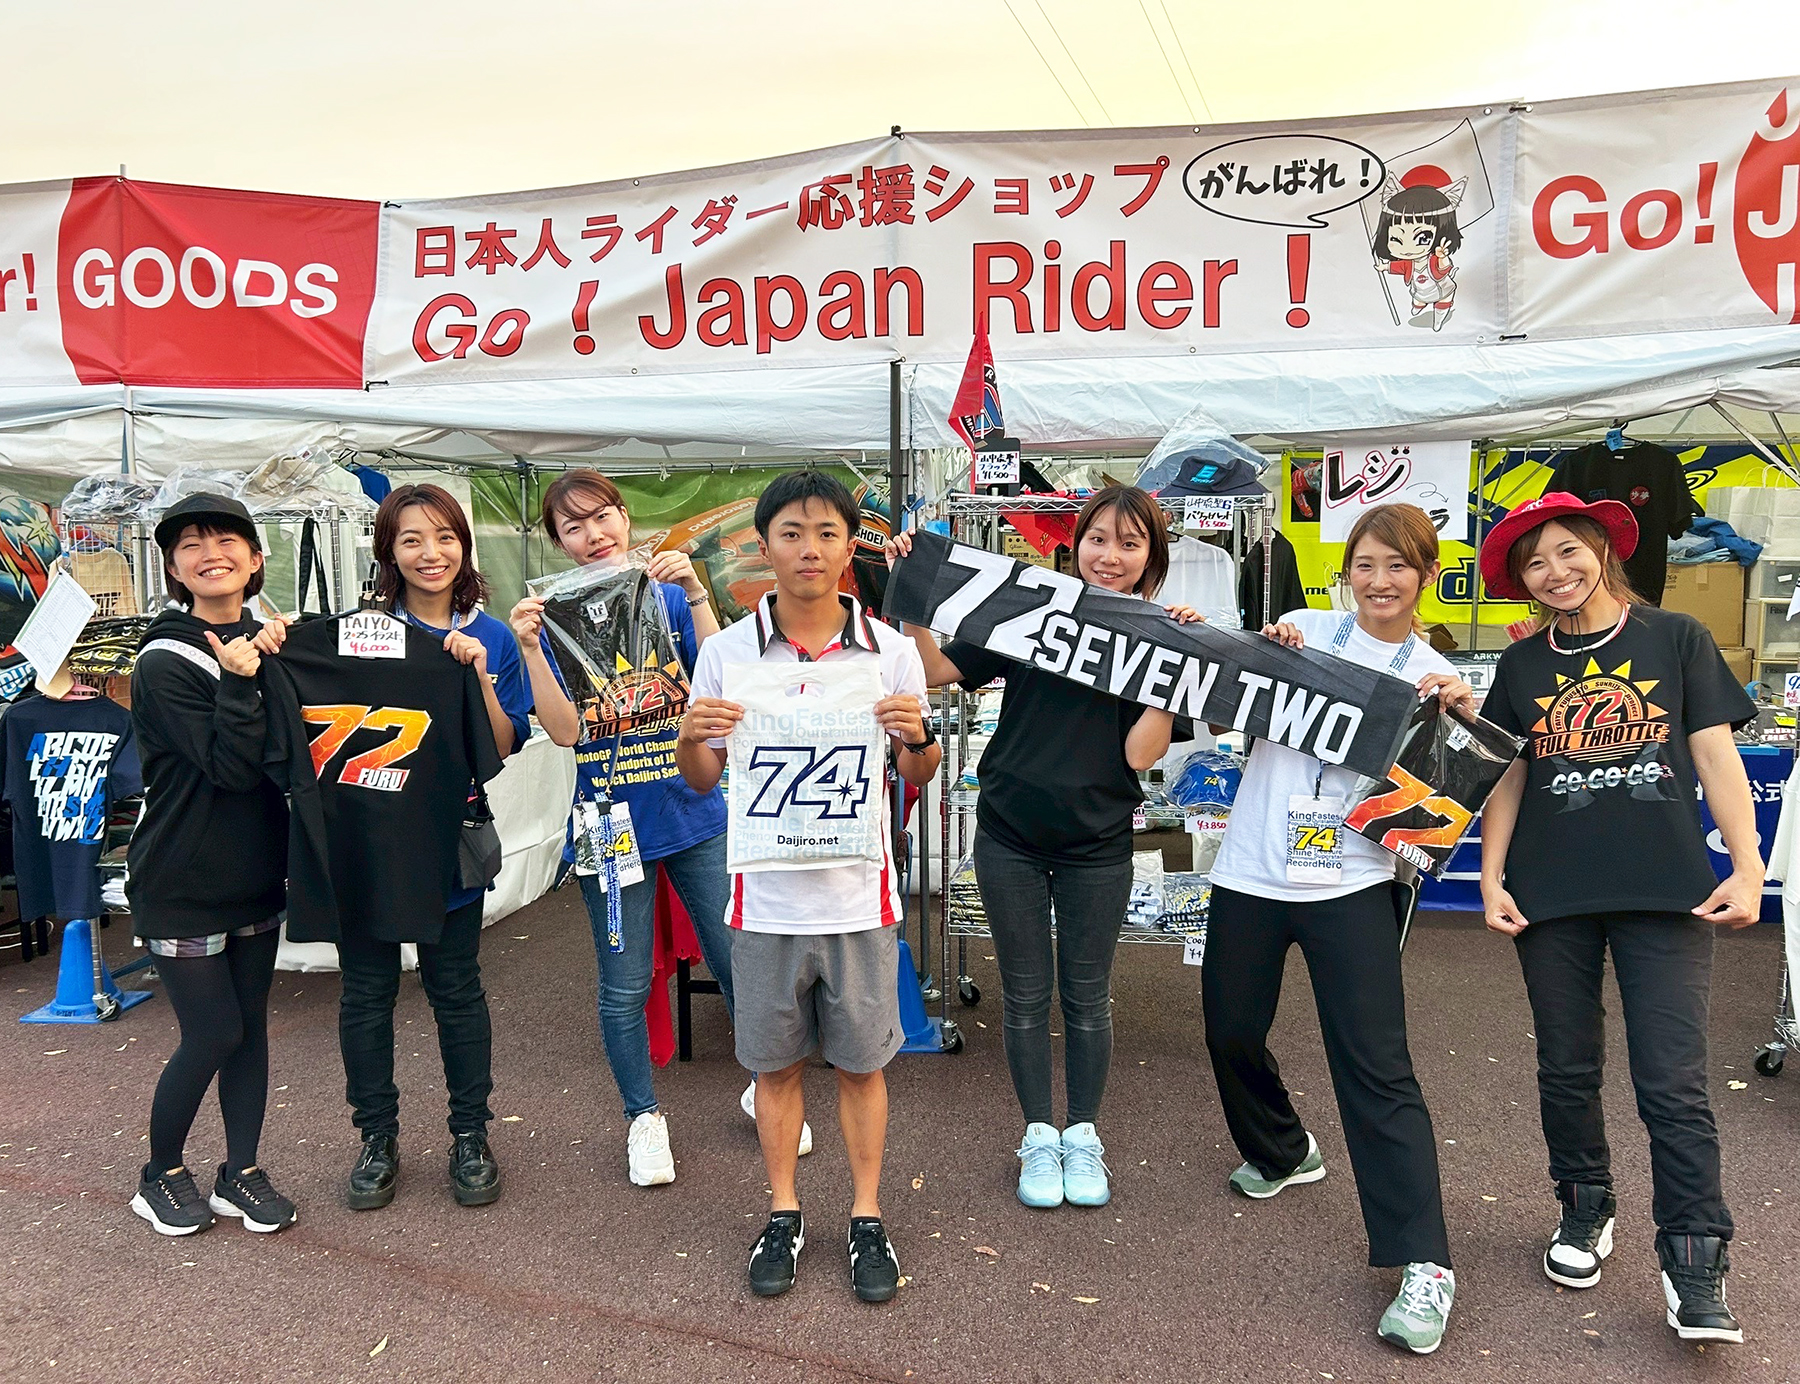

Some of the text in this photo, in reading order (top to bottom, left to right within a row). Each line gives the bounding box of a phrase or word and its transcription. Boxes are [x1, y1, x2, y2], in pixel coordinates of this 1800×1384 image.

[414, 155, 1171, 279] 日本人ライダー応援ショップ
[1531, 161, 1719, 260] Go!
[73, 245, 339, 320] GOODS
[637, 261, 924, 355] Japan
[972, 238, 1239, 336] Rider
[929, 543, 1085, 660] 72
[345, 616, 391, 631] TAIYO
[613, 678, 665, 718] 72
[1035, 610, 1364, 765] SEVEN TWO
[1568, 689, 1626, 731] 72
[301, 703, 433, 788] 72
[576, 748, 612, 764] MotoGP
[1539, 723, 1664, 758] FULL THROTTLE
[357, 767, 406, 790] FURU
[602, 756, 654, 774] Gandprix
[653, 756, 665, 767] of
[626, 769, 661, 785] Daijiro
[746, 745, 871, 819] 74
[1203, 776, 1218, 786] 74
[1287, 810, 1312, 822] King
[1343, 761, 1475, 851] 72
[777, 834, 839, 847] Daijiro.net
[1294, 825, 1337, 852] 74
[1286, 858, 1318, 867] Record
[1318, 859, 1342, 869] Hero
